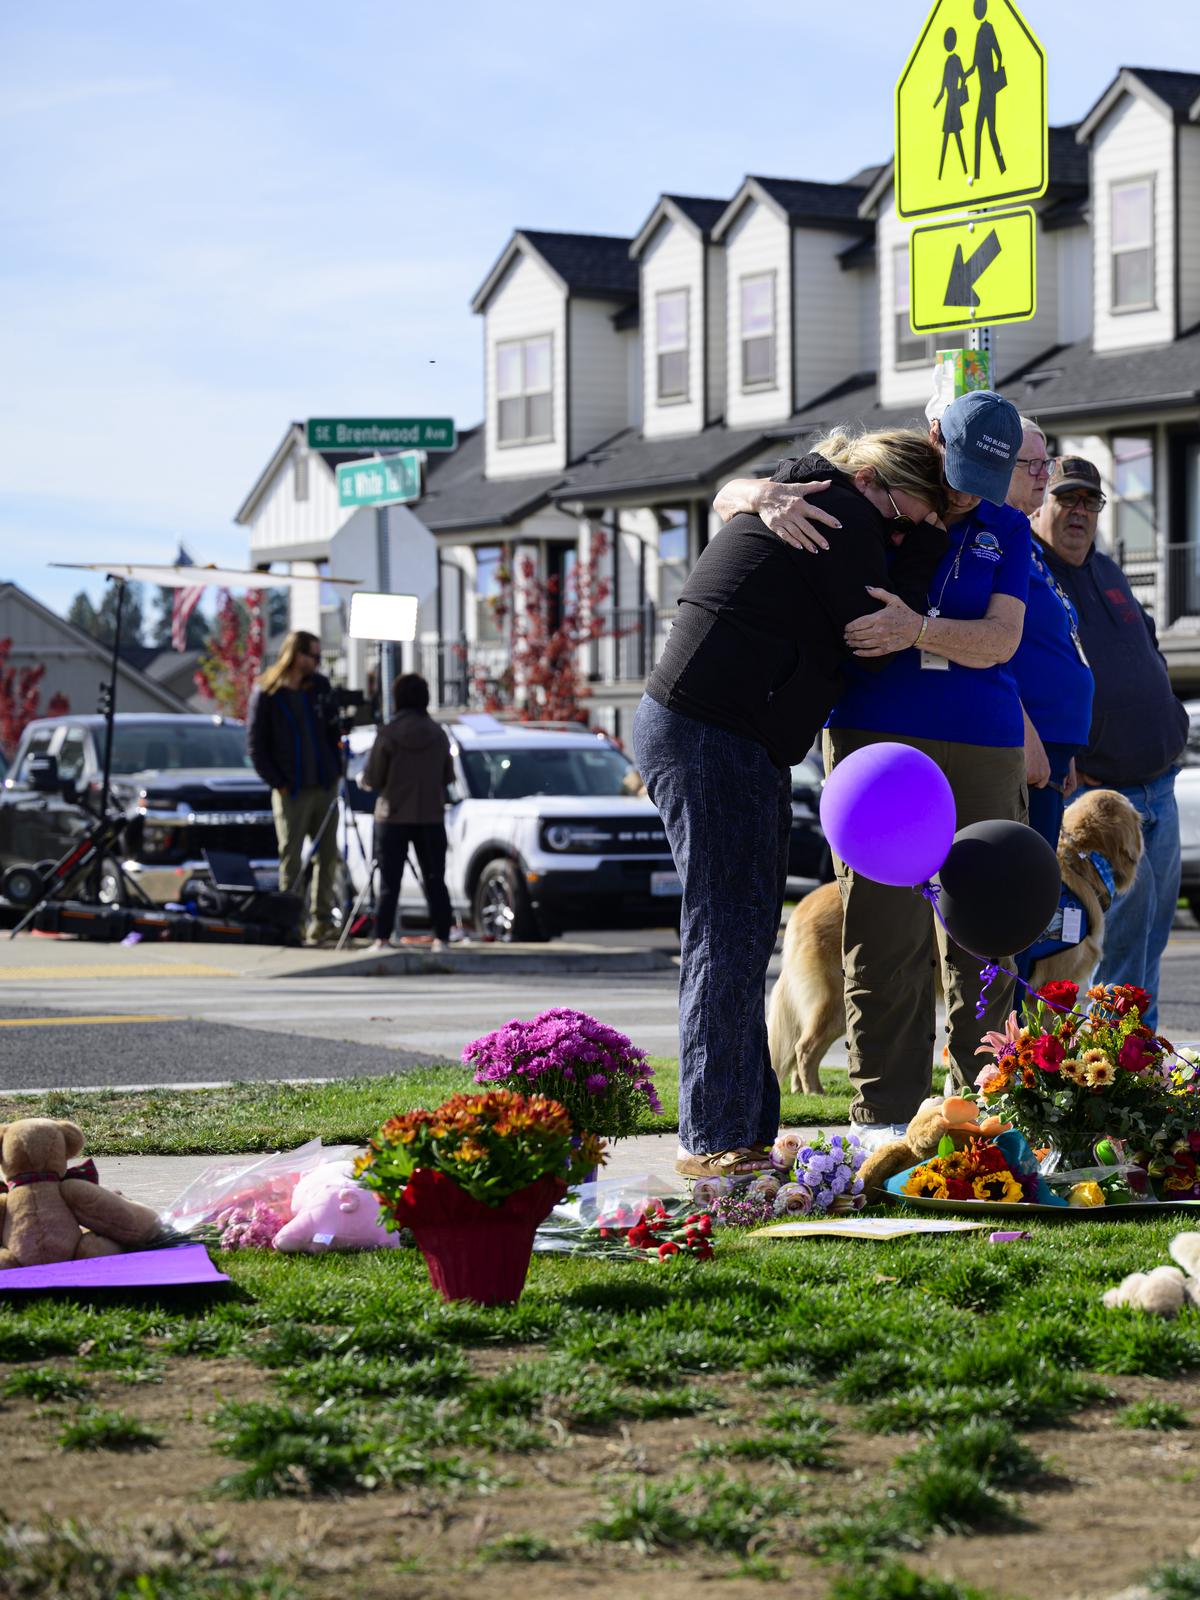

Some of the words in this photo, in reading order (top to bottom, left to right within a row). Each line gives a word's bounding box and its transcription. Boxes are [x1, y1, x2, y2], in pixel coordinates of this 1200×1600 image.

[315, 425, 331, 441] SE
[336, 424, 420, 443] Brentwood
[424, 427, 448, 441] Ave
[982, 434, 993, 443] TOO
[976, 440, 984, 448] TO
[982, 443, 990, 451] BE
